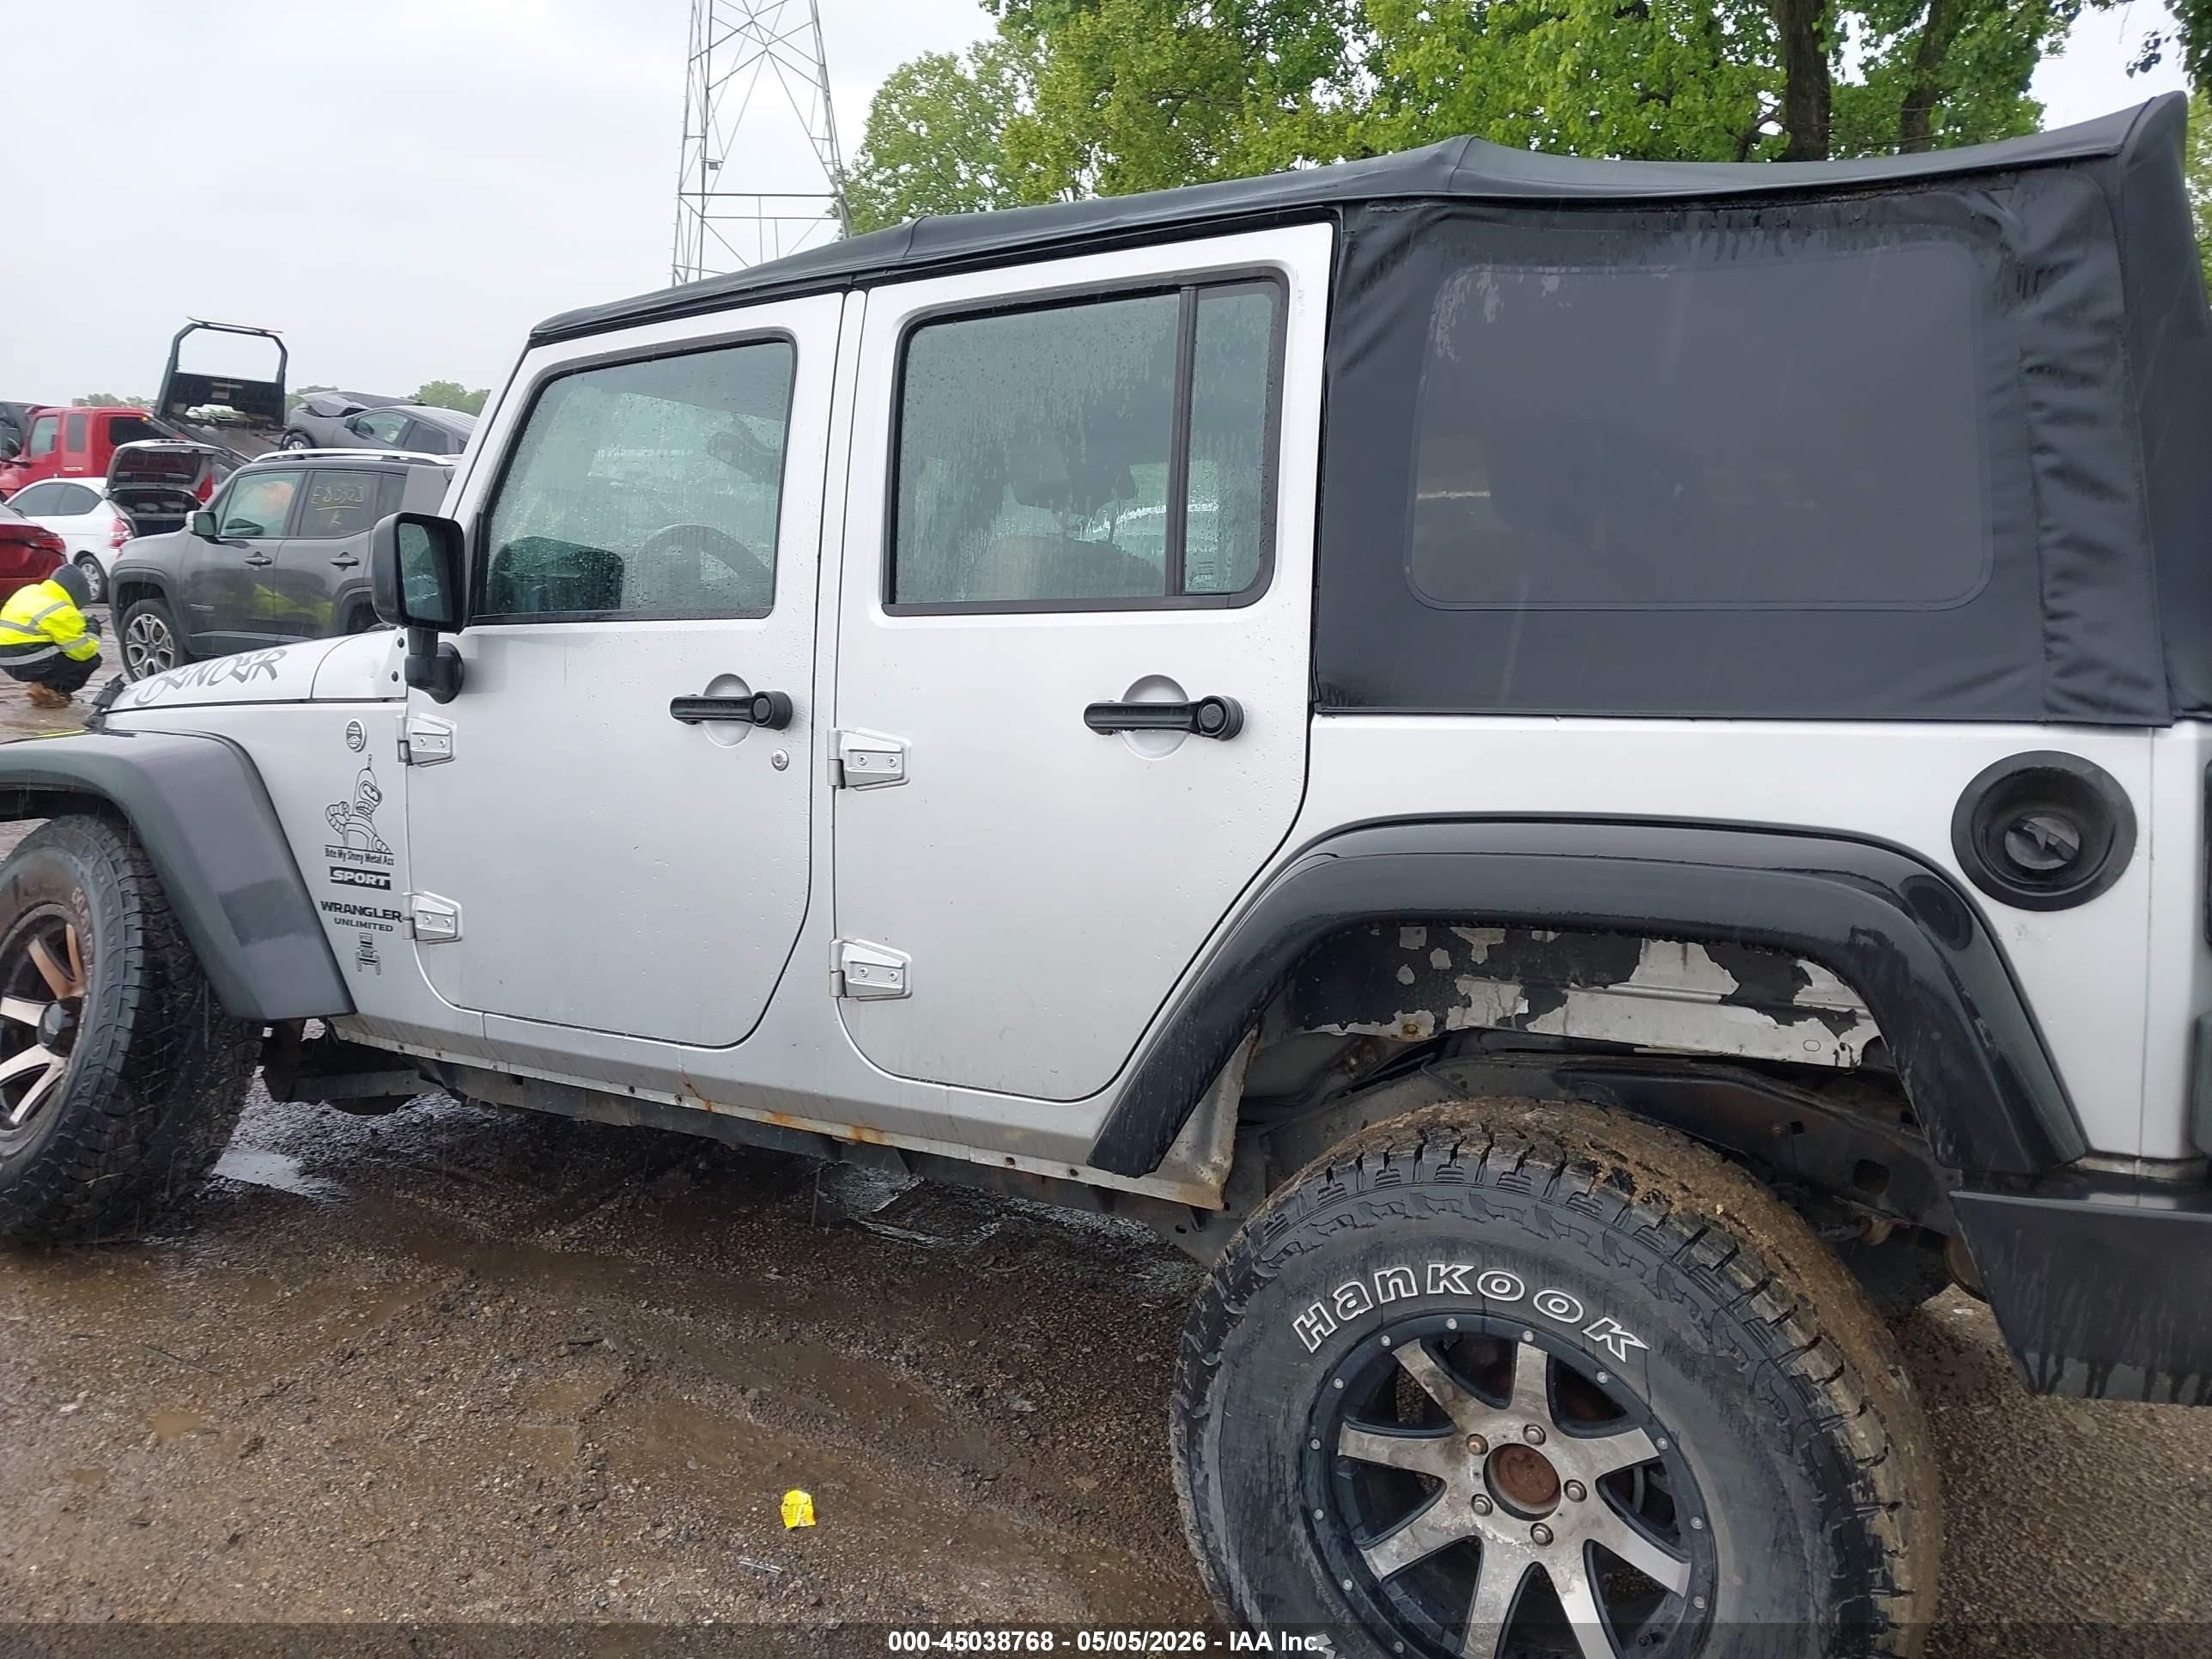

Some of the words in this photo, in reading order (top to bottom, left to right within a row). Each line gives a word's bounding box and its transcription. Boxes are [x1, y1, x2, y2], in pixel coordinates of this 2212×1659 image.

[331, 870, 386, 886] SPORT
[320, 901, 403, 923] WRANGLER
[334, 917, 393, 933] UNLIMITED
